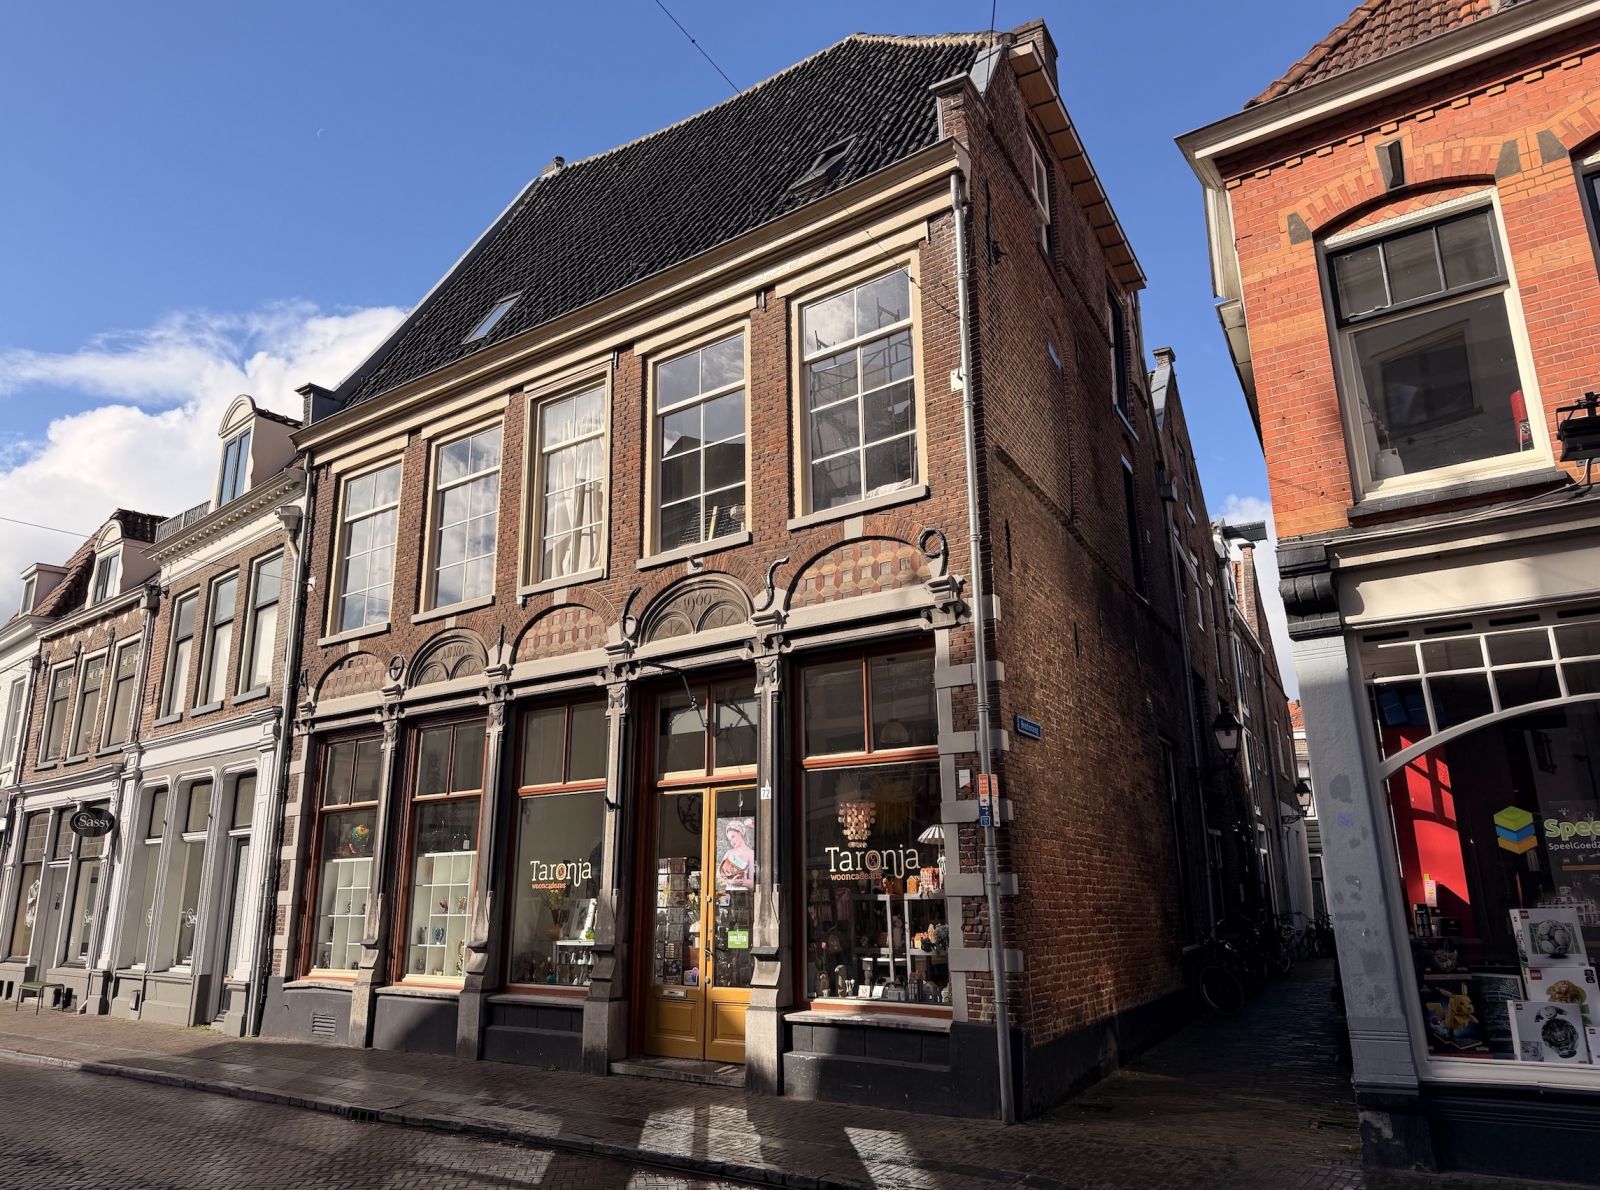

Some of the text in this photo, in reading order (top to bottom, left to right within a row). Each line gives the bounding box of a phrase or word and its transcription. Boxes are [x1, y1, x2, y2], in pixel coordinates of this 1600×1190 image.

[683, 593, 712, 615] 1900
[441, 645, 465, 660] ANNO
[761, 789, 770, 798] 72
[78, 815, 110, 830] Sassy
[824, 843, 921, 879] Taronja
[530, 858, 592, 887] Taronja
